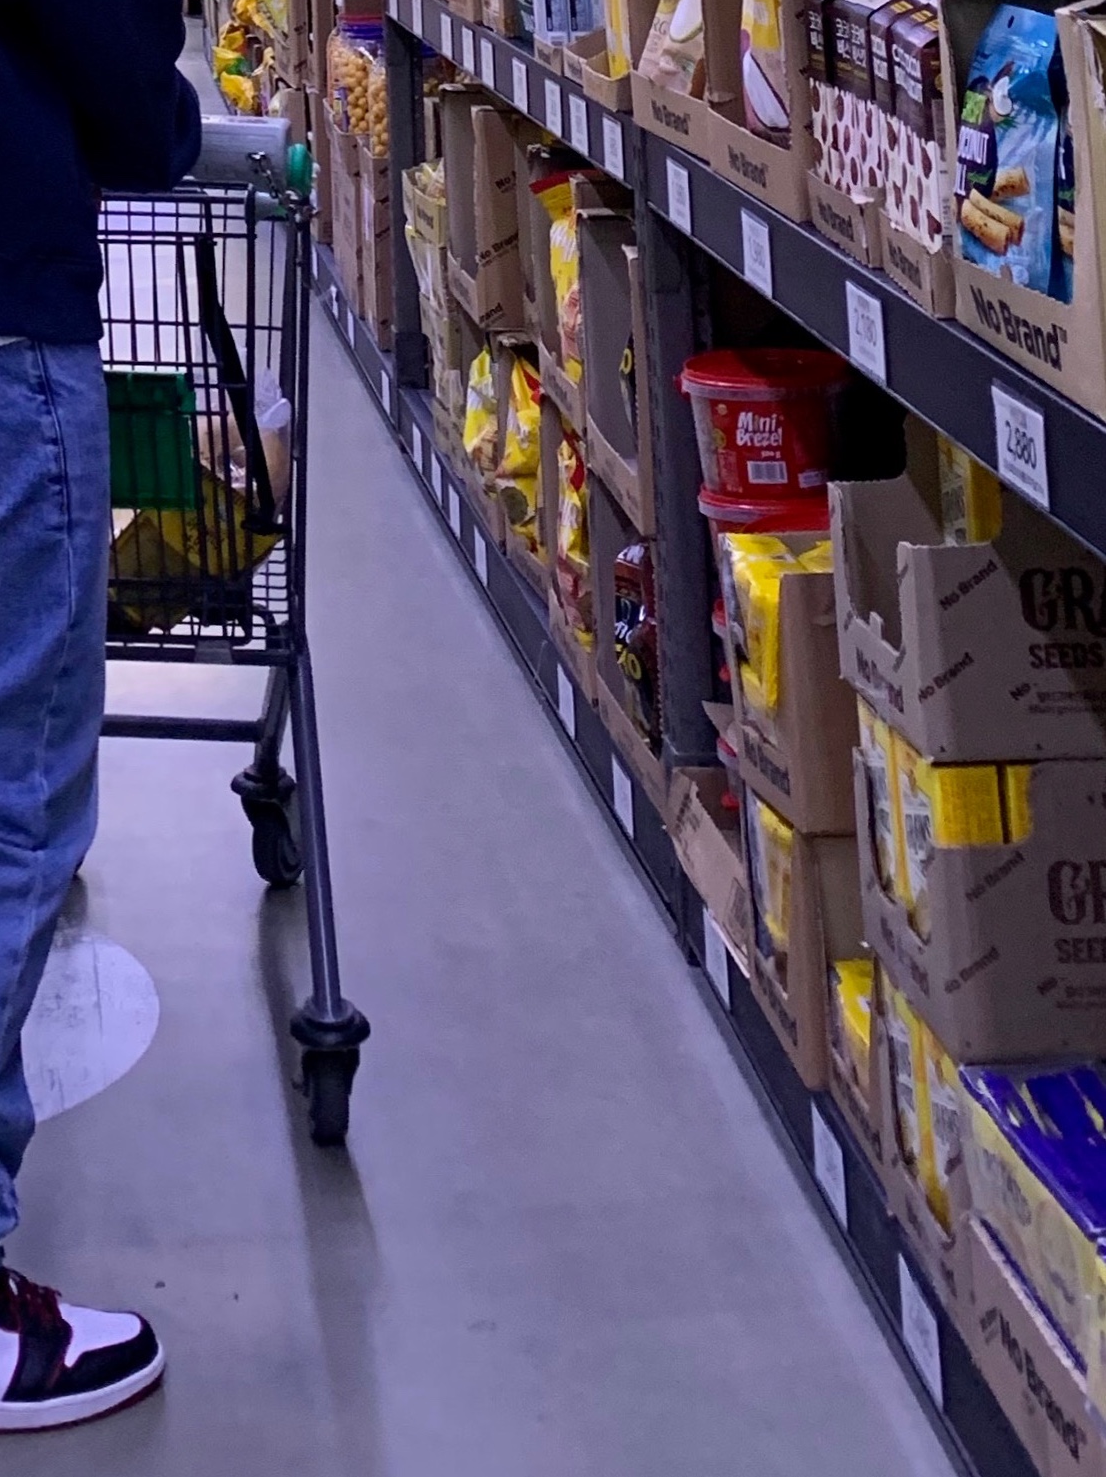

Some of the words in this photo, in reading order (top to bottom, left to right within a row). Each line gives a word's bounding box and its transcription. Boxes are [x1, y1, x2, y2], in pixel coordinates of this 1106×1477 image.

[970, 284, 1000, 336] No
[736, 426, 783, 447] Brezel
[737, 411, 778, 433] Mini
[939, 591, 960, 611] No
[957, 558, 999, 595] Brand
[1019, 566, 1106, 638] GR
[918, 684, 935, 704] No
[933, 651, 974, 690] Brand
